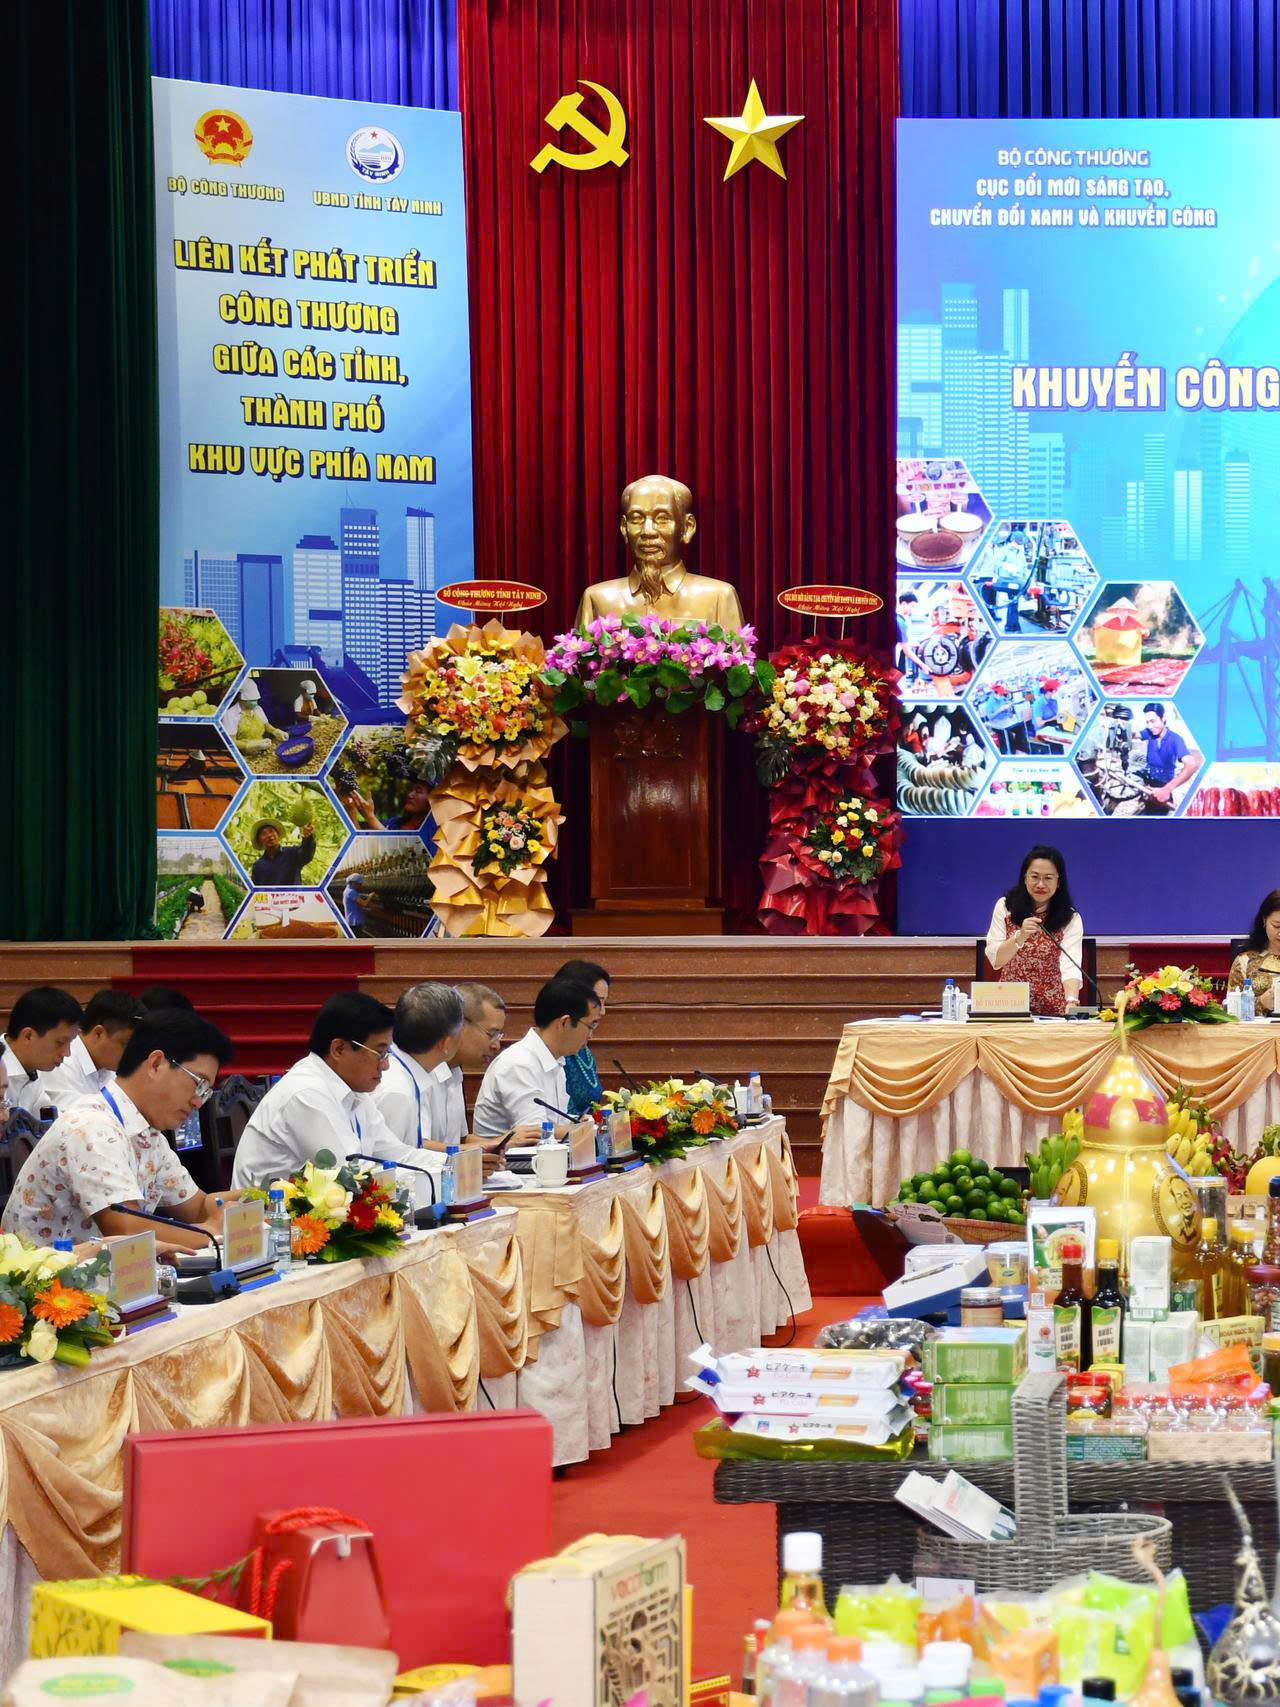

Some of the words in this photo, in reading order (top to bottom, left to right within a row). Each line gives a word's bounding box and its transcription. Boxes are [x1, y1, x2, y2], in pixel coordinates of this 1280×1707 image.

[998, 148, 1022, 168] BỘ
[1024, 147, 1073, 166] CÔNG
[1075, 148, 1150, 166] THƯƠNG
[168, 177, 187, 195] BỘ
[191, 178, 228, 198] CÔNG
[232, 182, 284, 202] THƯƠNG
[313, 190, 350, 209] UBND
[352, 191, 383, 211] TỈNH
[386, 195, 409, 214] TÂY
[411, 199, 443, 217] NINH
[976, 178, 1010, 200] CỤC
[1013, 172, 1042, 197] ĐỔI
[1047, 176, 1081, 197] MỚI
[1085, 176, 1130, 197] SÁNG
[1134, 177, 1171, 200] TẠO,
[930, 202, 993, 227] CHUYỂN
[997, 201, 1026, 227] ĐỔI
[1030, 208, 1074, 227] XANH
[1078, 206, 1100, 227] VÀ
[1104, 201, 1168, 228] KHUYẾN
[1172, 204, 1217, 228] CÔNG
[174, 236, 234, 273] LIÊN
[239, 236, 288, 277] KẾT
[293, 247, 359, 283] PHÁT
[364, 248, 437, 289] TRIỂN
[219, 291, 292, 327] CÔNG
[297, 299, 400, 335] THƯƠNG
[213, 340, 278, 378] GIỮA
[283, 344, 337, 380] CÁC
[341, 346, 408, 386] TỈNH,
[1012, 352, 1165, 412] KHUYẾN
[240, 393, 327, 429] THÀNH
[332, 394, 385, 433] PHỐ
[188, 443, 244, 474] KHU
[249, 446, 303, 482] VỰC
[309, 447, 371, 481] PHÍA
[376, 454, 437, 484] NAM
